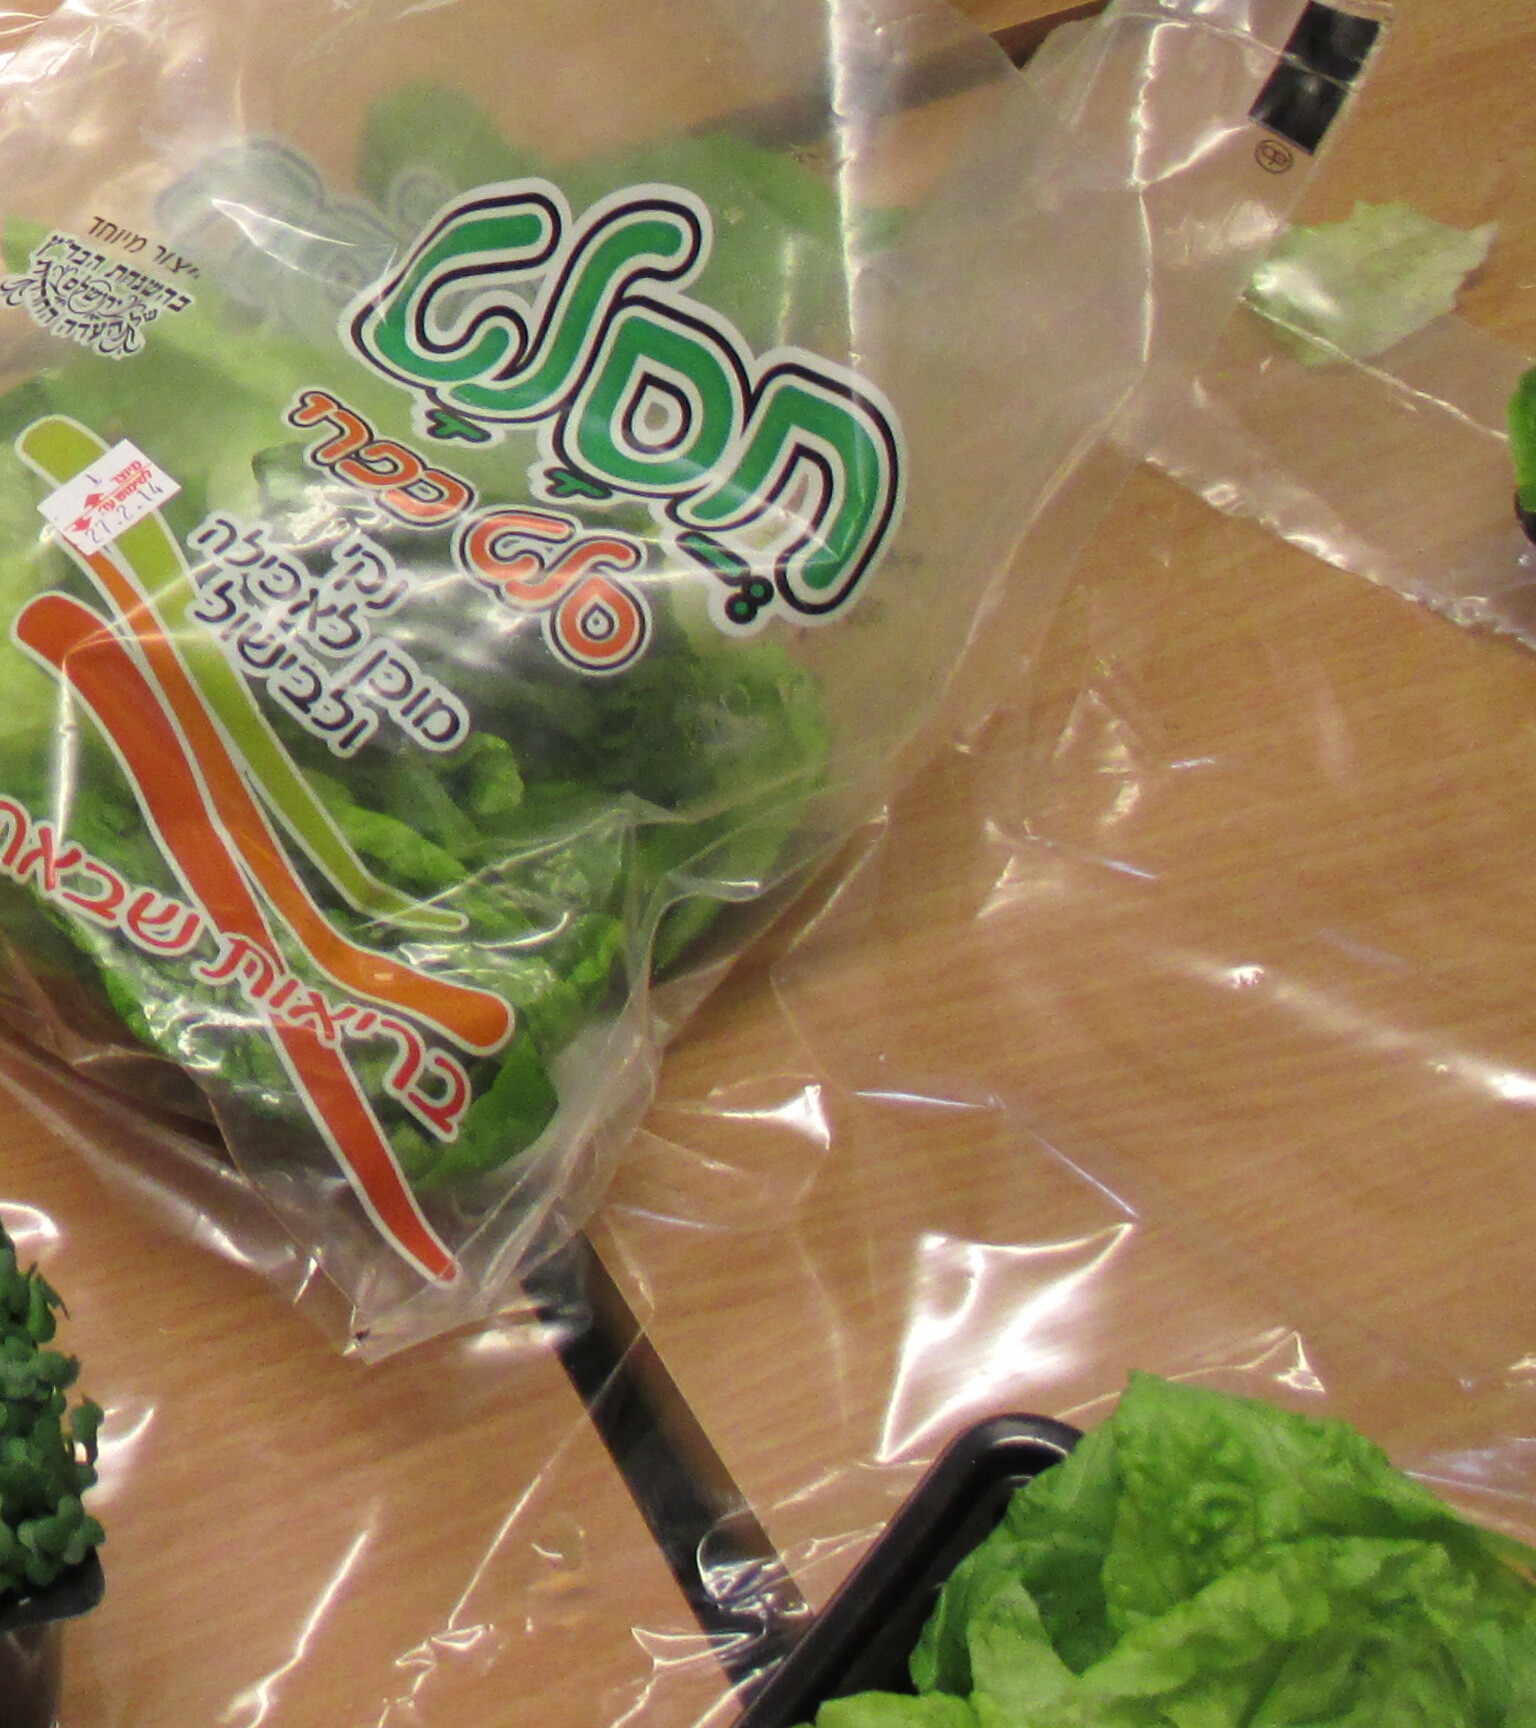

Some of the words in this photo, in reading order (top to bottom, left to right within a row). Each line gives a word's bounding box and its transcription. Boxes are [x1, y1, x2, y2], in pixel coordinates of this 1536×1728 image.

[87, 215, 148, 254] מיוחד
[103, 263, 193, 313] בהשגחת
[288, 390, 475, 528] כפרי
[196, 518, 363, 651] לאכילה
[333, 543, 409, 611] נקי
[458, 510, 653, 671] סלט
[193, 580, 370, 750] ולבישול
[349, 649, 461, 744] מוכן
[199, 931, 466, 1135] בריאות
